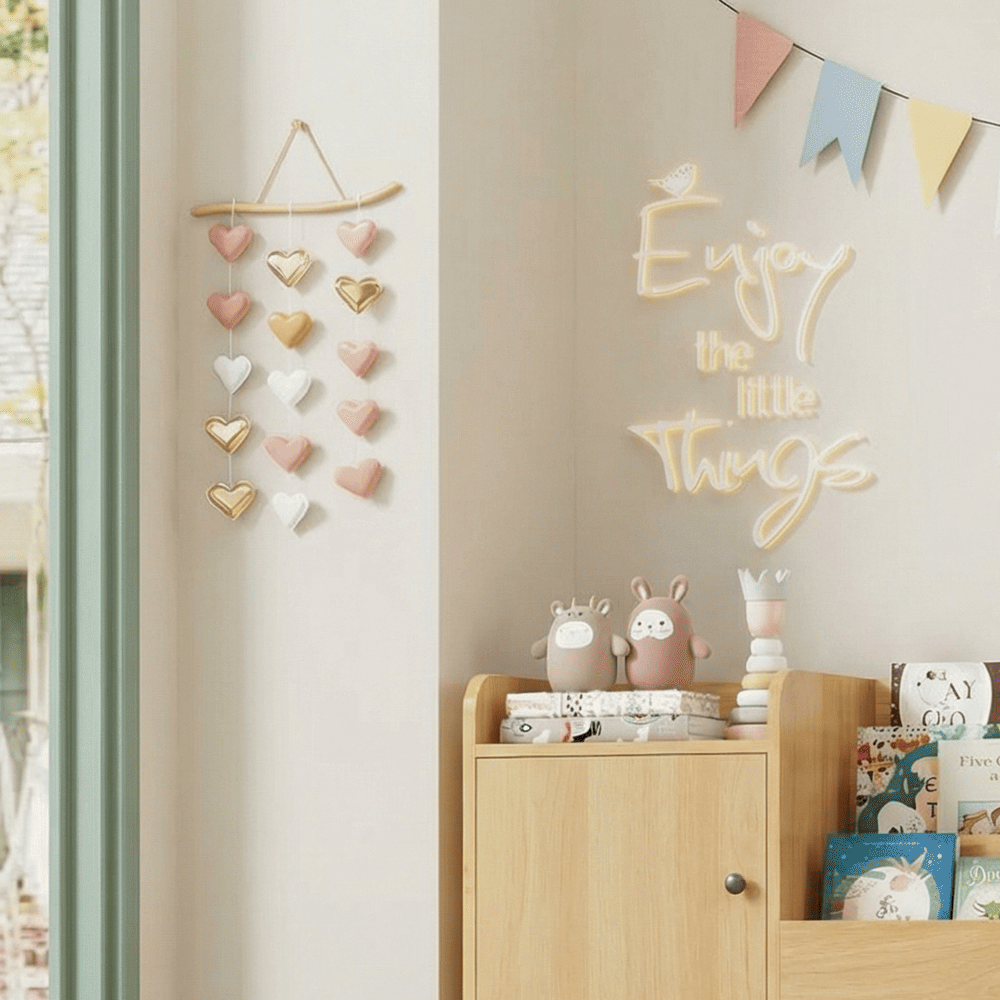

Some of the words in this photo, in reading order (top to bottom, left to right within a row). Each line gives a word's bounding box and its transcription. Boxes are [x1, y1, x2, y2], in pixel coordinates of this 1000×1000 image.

[633, 196, 855, 364] Enjoy
[695, 331, 753, 371] the
[737, 375, 818, 418] little
[627, 410, 877, 548] Things
[959, 754, 992, 768] Five
